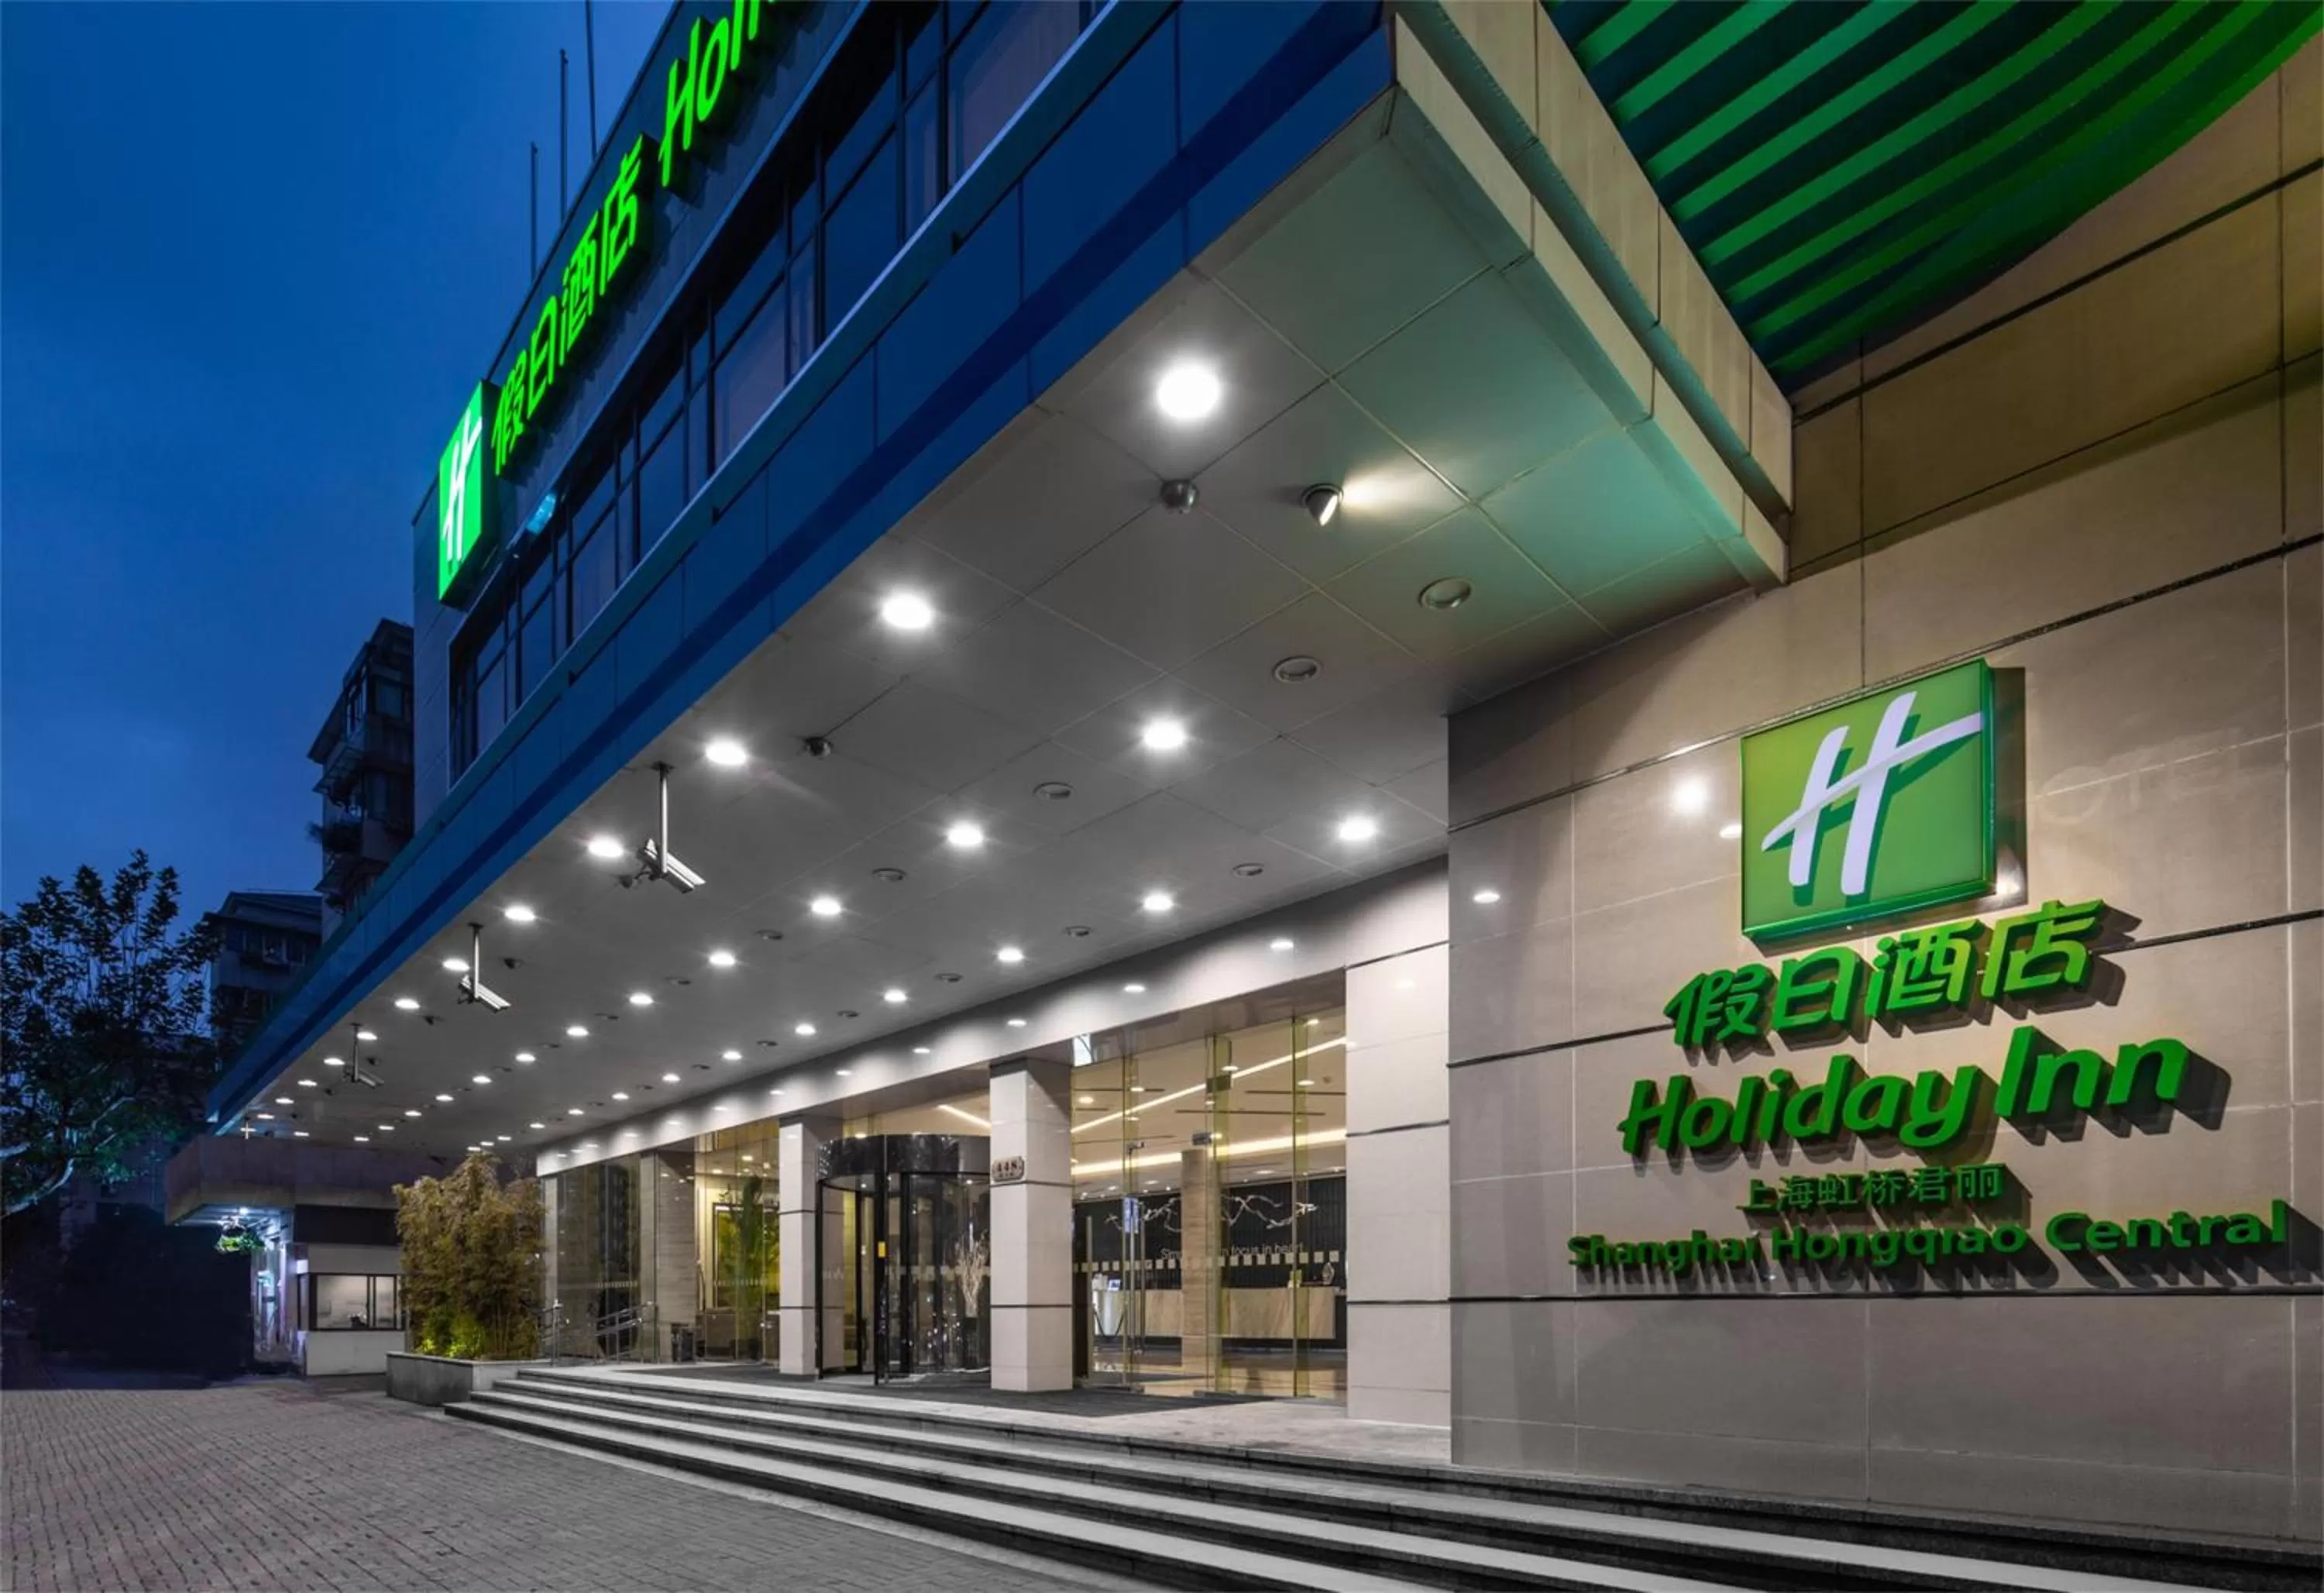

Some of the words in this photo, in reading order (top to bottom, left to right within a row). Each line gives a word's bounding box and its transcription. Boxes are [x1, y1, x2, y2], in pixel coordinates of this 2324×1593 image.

[490, 132, 642, 476] 假日酒店
[1761, 690, 1983, 896] H
[1663, 900, 2104, 1048] 假日酒店
[1618, 1053, 1988, 1154] Holiday
[1993, 1025, 2189, 1118] Inn
[1567, 1229, 1762, 1271] Shanghai
[1771, 1221, 2028, 1267] Hongqiao
[2045, 1199, 2288, 1252] Central
[1735, 1163, 2006, 1211] 上海虹桥君丽
